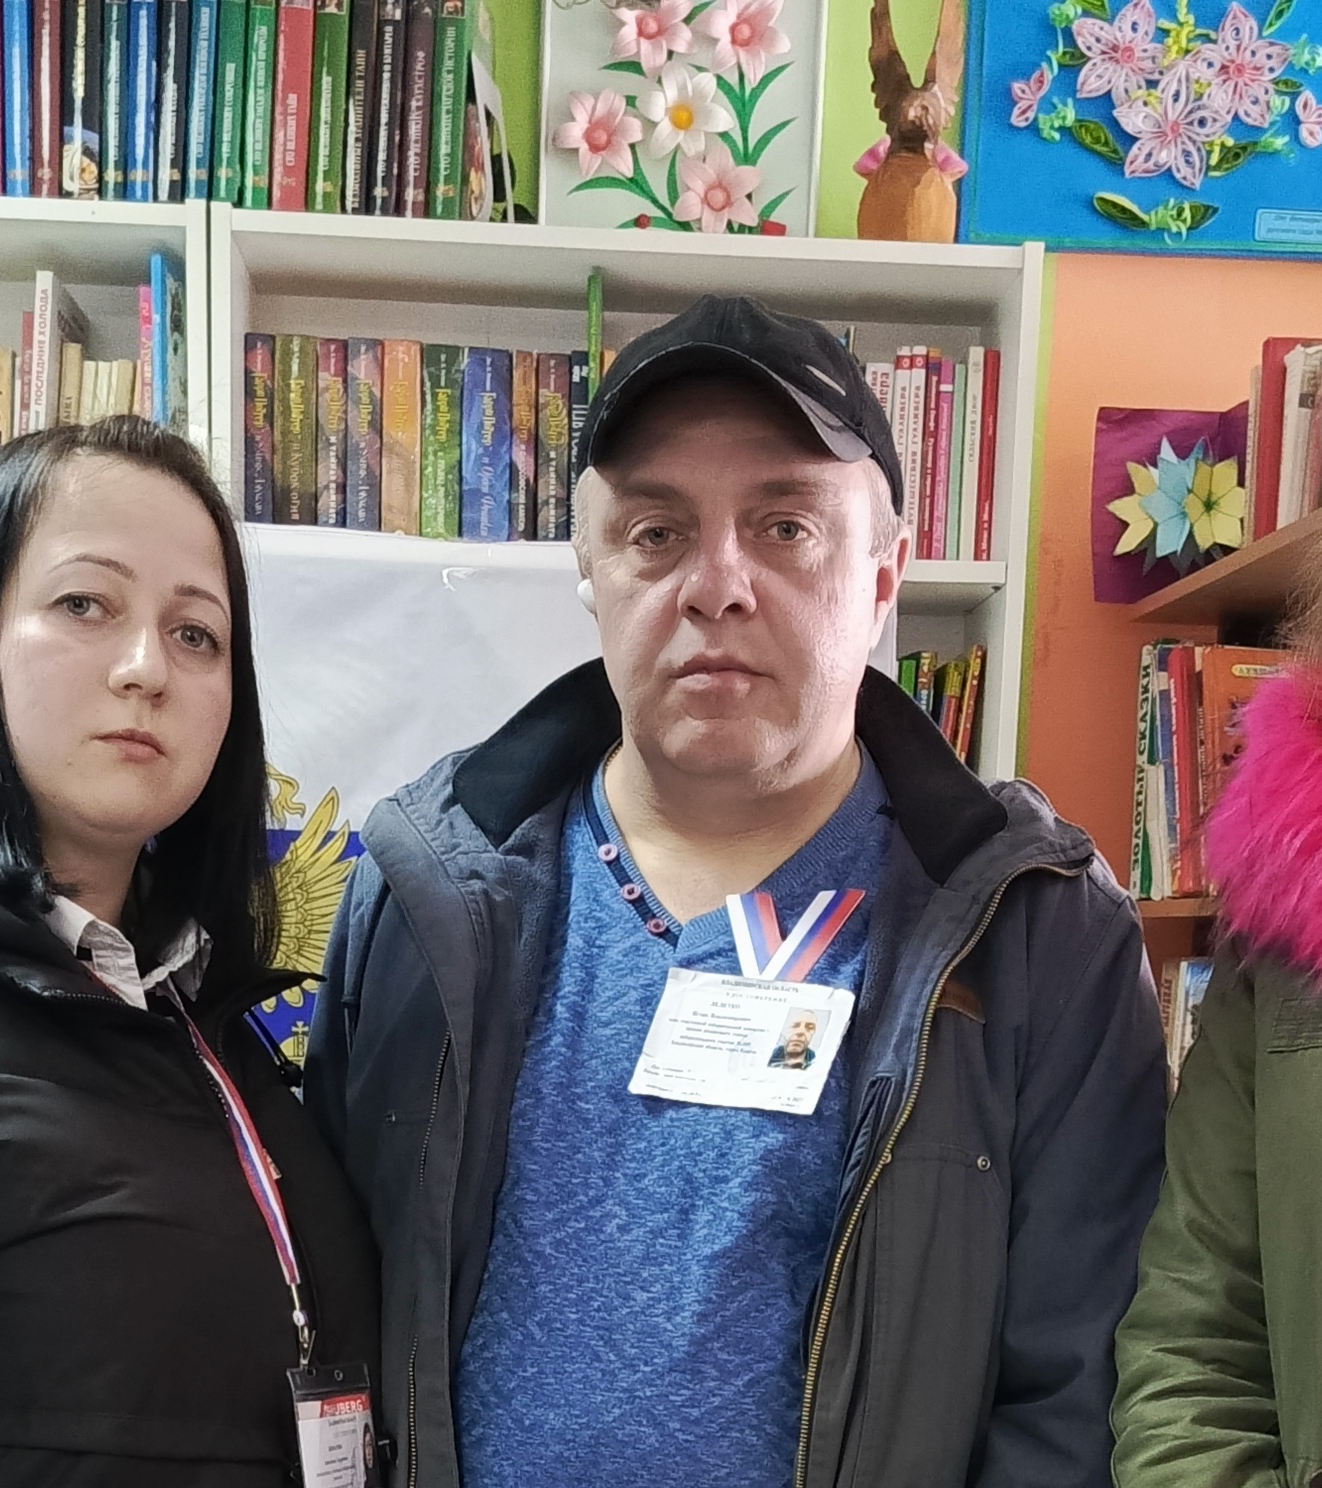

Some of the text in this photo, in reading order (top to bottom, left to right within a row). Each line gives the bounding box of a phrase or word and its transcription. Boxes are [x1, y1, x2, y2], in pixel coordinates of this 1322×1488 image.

[34, 287, 49, 407] ПОСЛЕДНИЕ ХОЛОДА
[480, 391, 497, 417] Гарри
[480, 417, 496, 448] Поттер
[1138, 663, 1152, 757] СКАЗКИ
